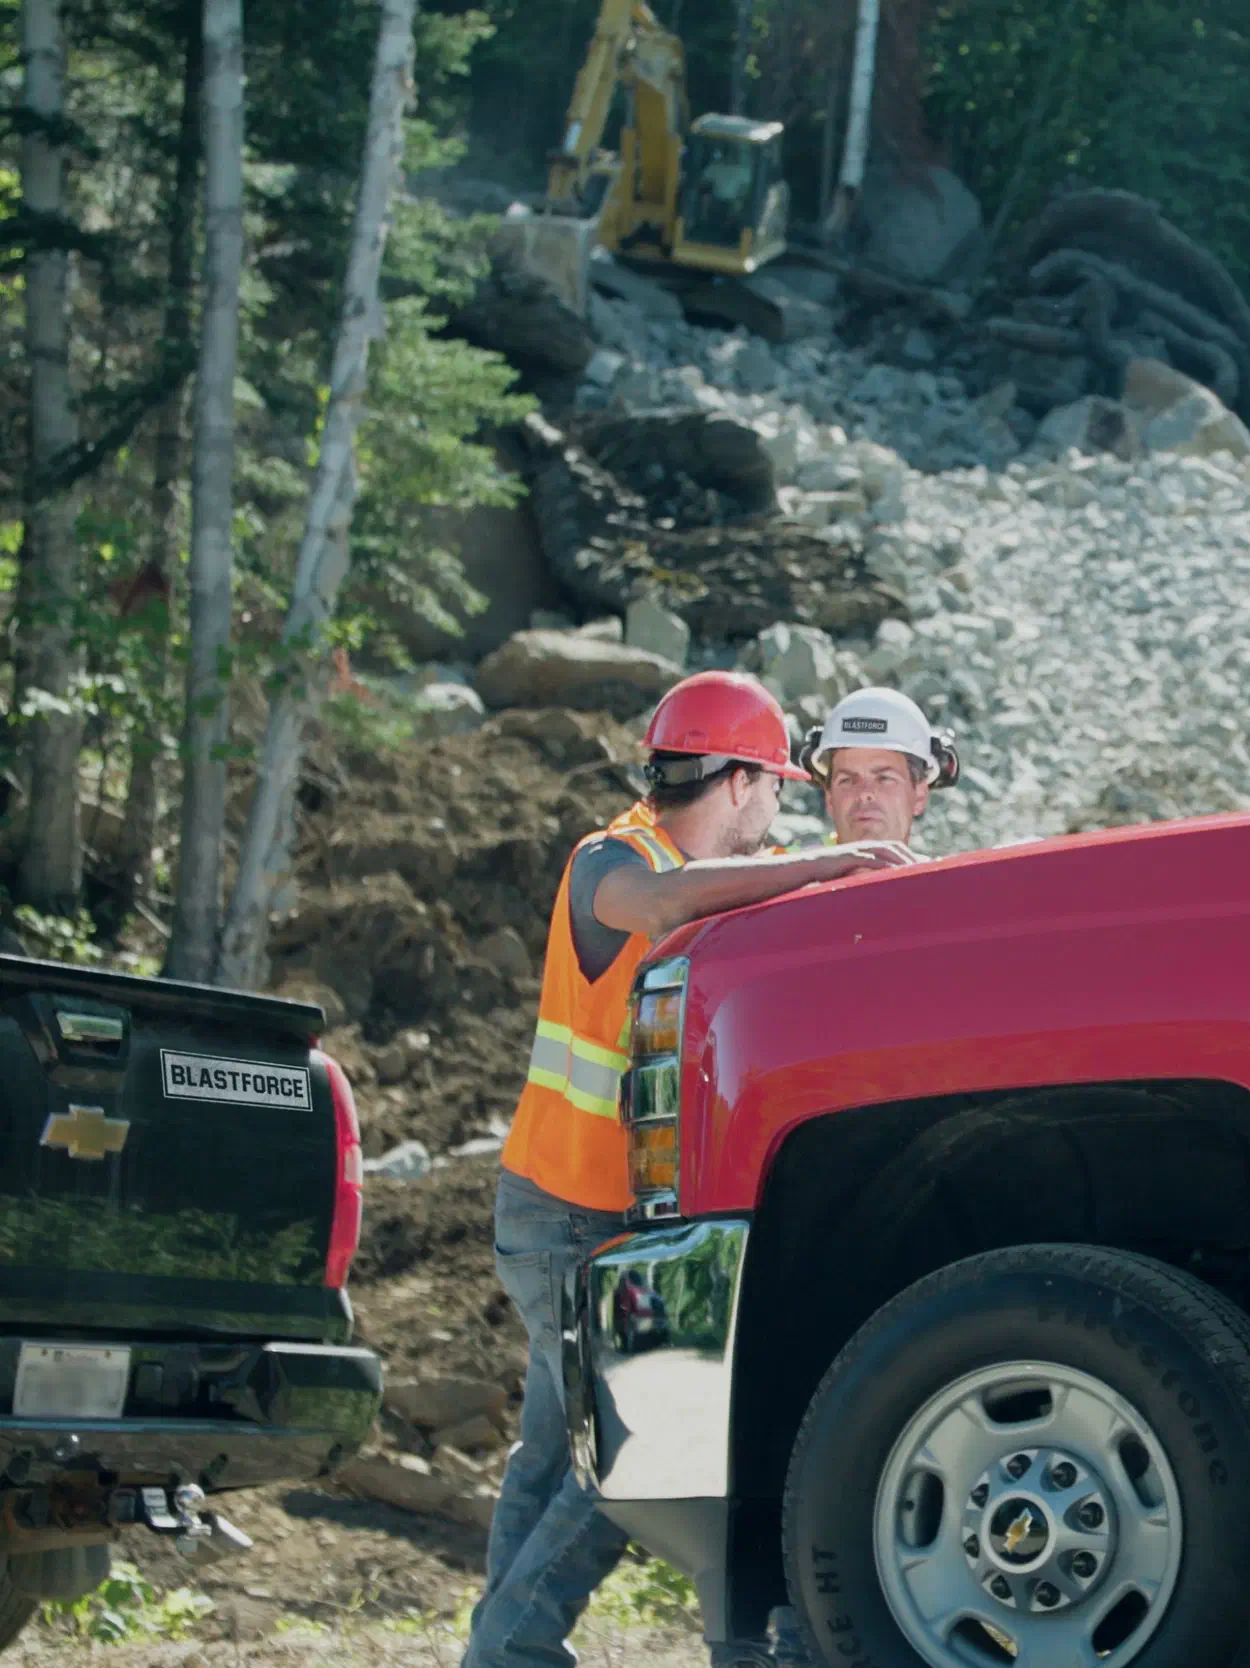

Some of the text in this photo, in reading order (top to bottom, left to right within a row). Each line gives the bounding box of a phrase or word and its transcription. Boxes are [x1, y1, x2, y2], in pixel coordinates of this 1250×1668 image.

[843, 720, 885, 730] BLASTFORCE
[170, 1064, 304, 1099] BLASTFORCE
[811, 1545, 842, 1594] HT
